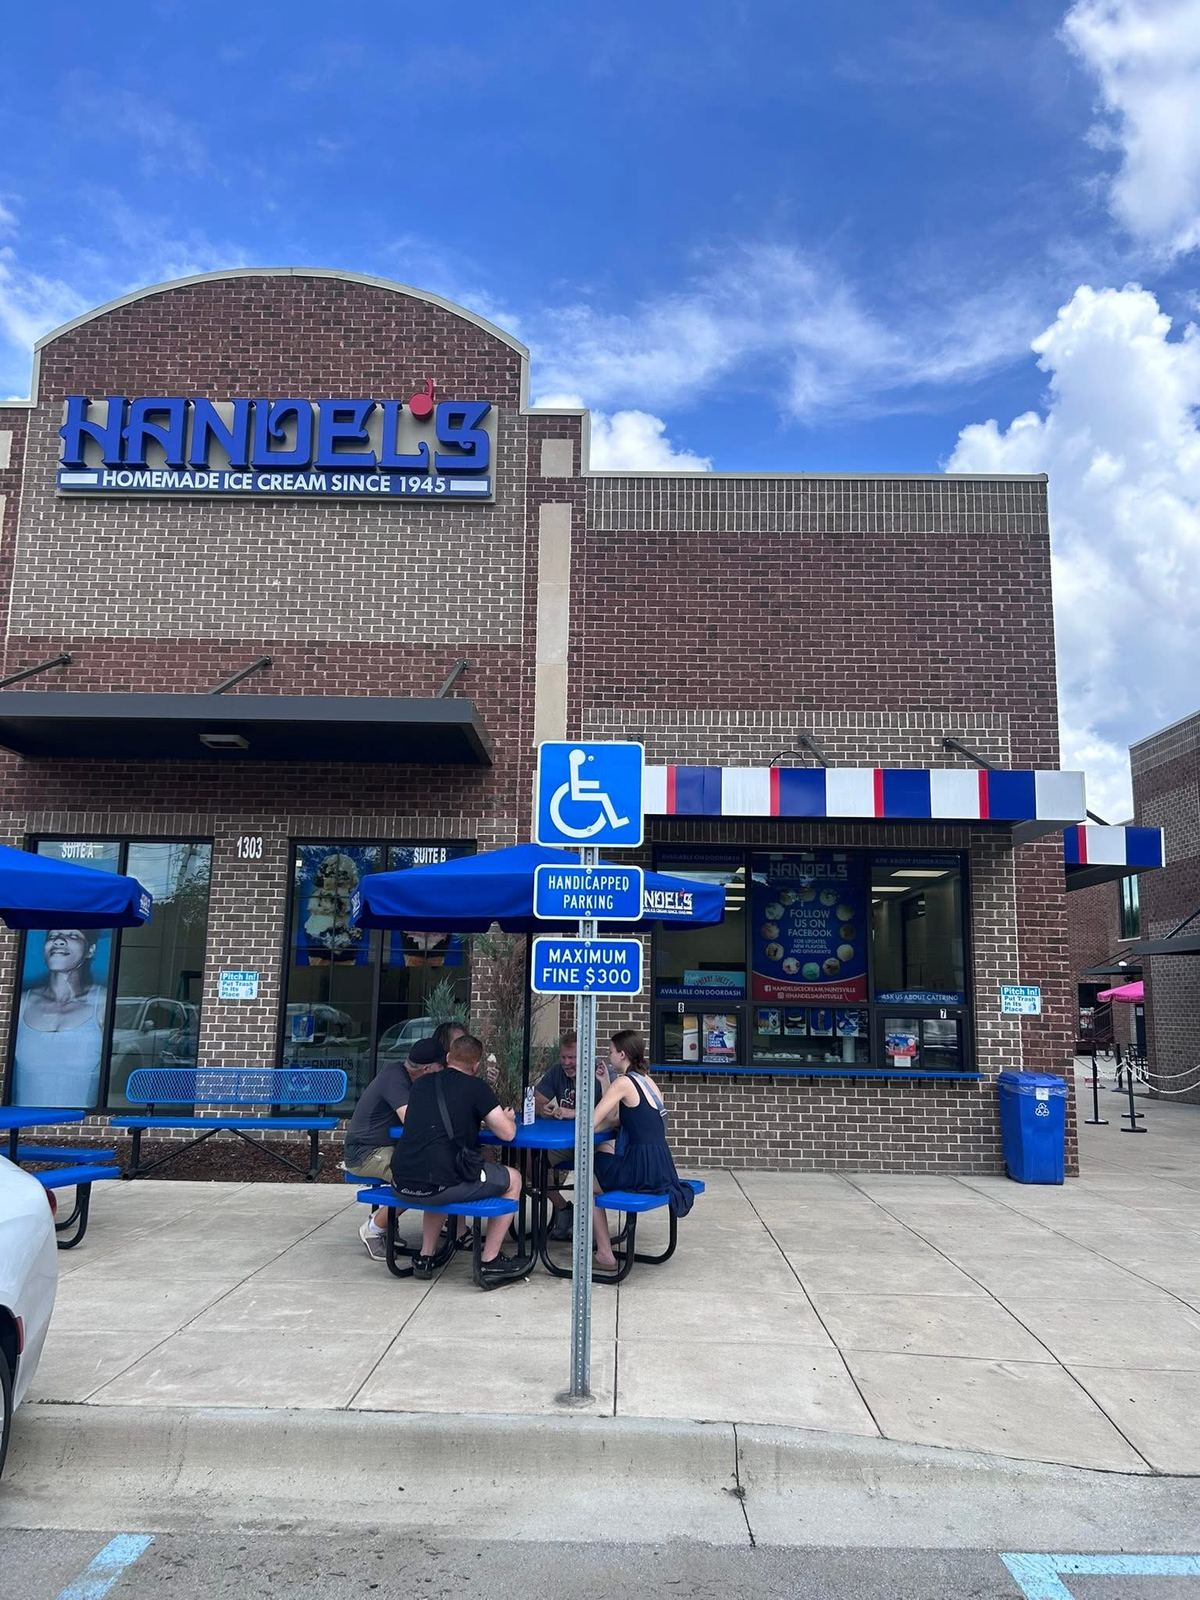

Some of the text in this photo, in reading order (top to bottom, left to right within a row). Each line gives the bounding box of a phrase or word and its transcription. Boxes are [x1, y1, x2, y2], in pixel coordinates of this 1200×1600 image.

[59, 378, 491, 474] HANDEL'S
[102, 470, 446, 493] HOMEMADE ICE CREAM SINCE 1945
[61, 842, 94, 859] SUITE A
[236, 836, 263, 859] 1303
[413, 847, 447, 864] SUITE B
[548, 875, 630, 891] HANDICAPPED
[563, 894, 614, 910] PARKING
[790, 909, 830, 918] FOLLOW
[794, 920, 826, 928] US ON
[788, 929, 832, 937] FACEBOOK
[549, 948, 626, 965] MAXIMUM
[222, 972, 243, 980] Pitch
[543, 967, 631, 985] FINE $300
[694, 988, 705, 996] ON
[705, 988, 741, 997] DOORDASH
[1004, 987, 1025, 995] Pitch
